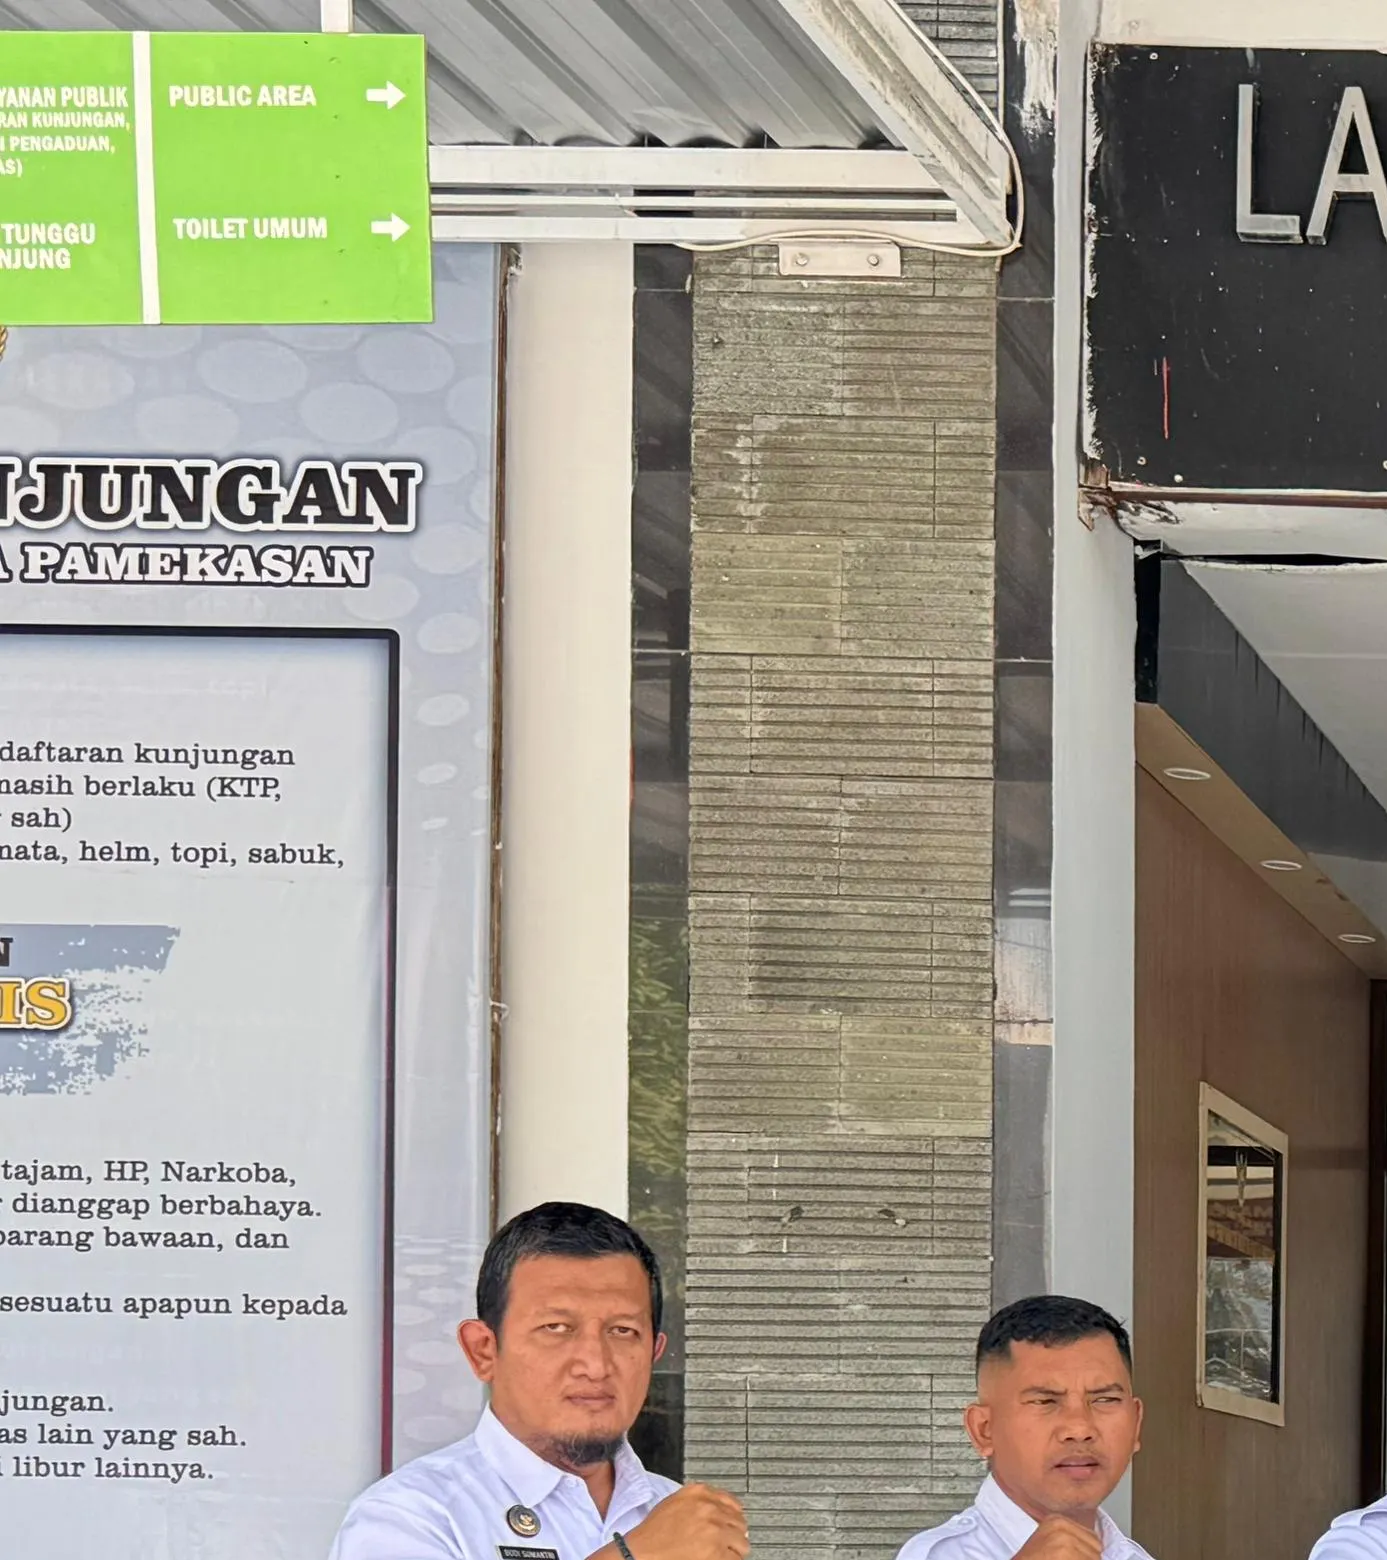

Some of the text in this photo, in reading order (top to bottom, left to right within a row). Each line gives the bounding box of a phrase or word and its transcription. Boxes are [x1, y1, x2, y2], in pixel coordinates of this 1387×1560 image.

[62, 86, 128, 108] PUBLIK
[169, 85, 316, 107] PUBLIC AREA
[32, 112, 130, 131] KUNJUNGAN,
[10, 135, 115, 154] PENGADUAN,
[1, 222, 96, 245] TUNGGU
[173, 217, 327, 239] TOILET UMUM
[0, 460, 420, 531] JUNGAN
[22, 543, 373, 586] PAMEKASAN
[134, 743, 296, 770] kunjungan
[85, 775, 196, 798] berlaku
[206, 776, 282, 802] (KTP,
[10, 807, 73, 833] sah)
[79, 841, 160, 867] helm,
[171, 842, 237, 868] topi,
[248, 843, 345, 869] sabuk,
[1, 1159, 297, 1188] tajam, HP, Narkoba,
[12, 1192, 322, 1222] dianggap berbahaya.
[104, 1226, 224, 1252] bawaan,
[235, 1228, 290, 1249] dan
[0, 1293, 348, 1320] sesuatu apapun kepada
[0, 1389, 114, 1417] jungan.
[38, 1423, 94, 1444] lain
[103, 1424, 178, 1451] yang
[187, 1425, 247, 1447] sah.
[12, 1456, 214, 1484] libur lainnya.
